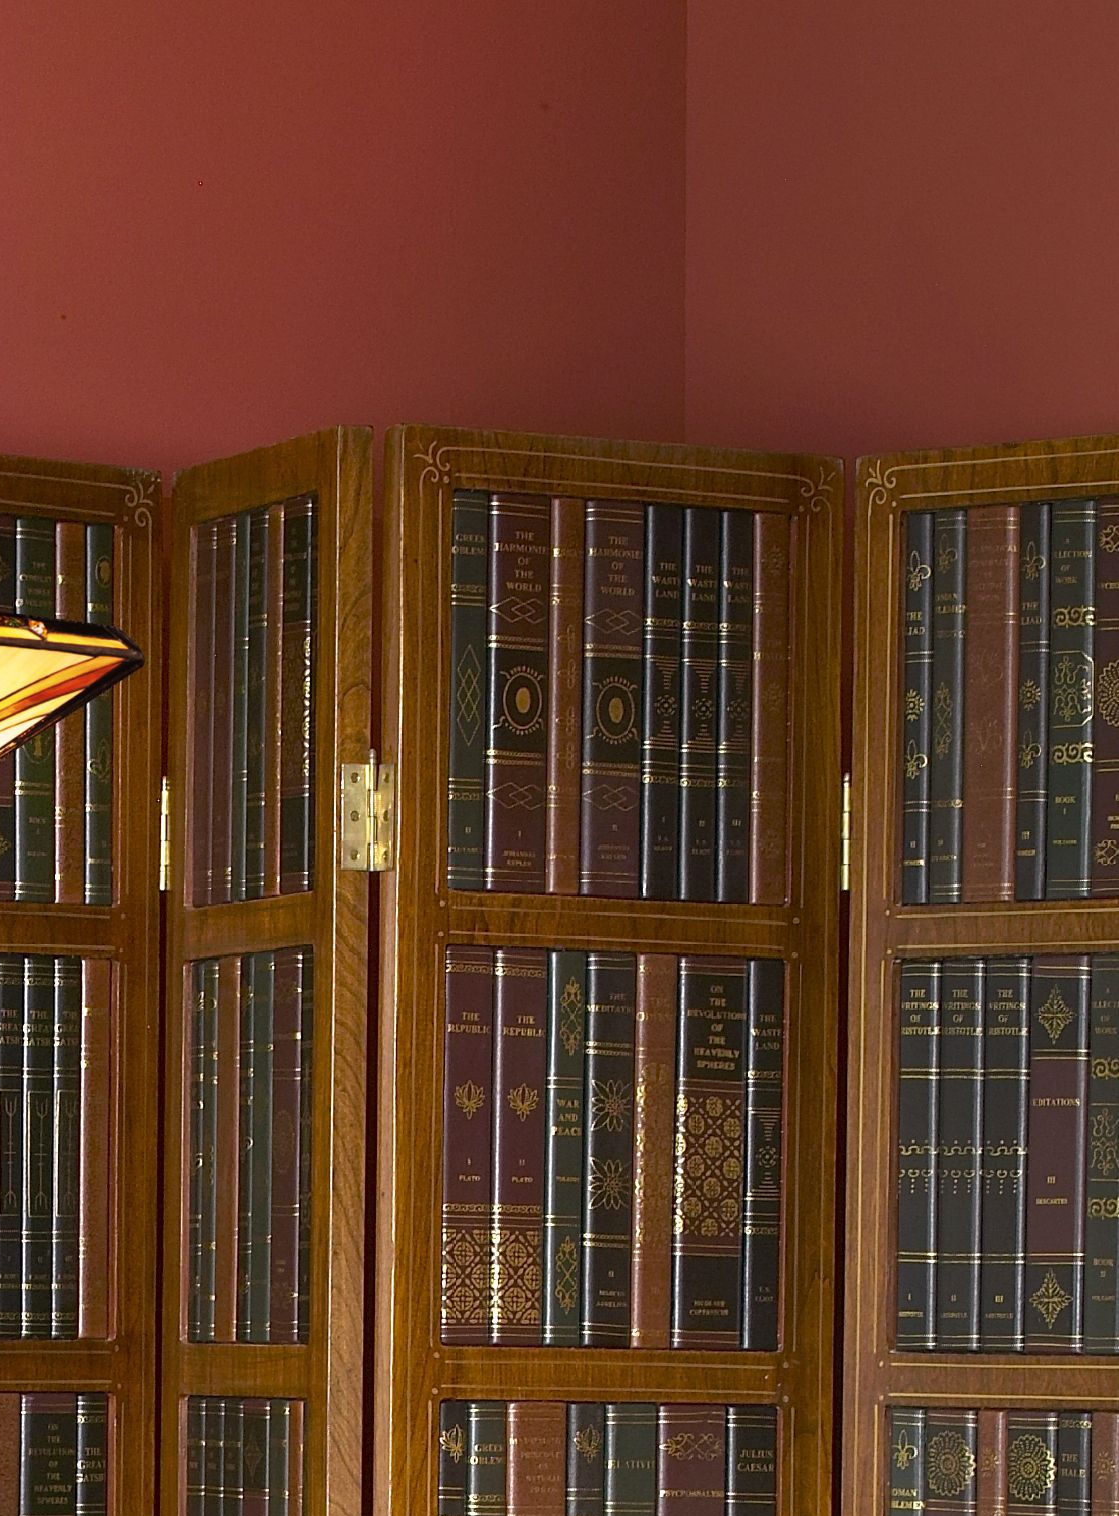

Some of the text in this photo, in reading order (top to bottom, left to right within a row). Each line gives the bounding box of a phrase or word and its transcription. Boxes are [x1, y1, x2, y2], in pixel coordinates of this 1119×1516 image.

[507, 582, 541, 592] WORLD
[740, 1450, 773, 1458] JULIUS
[738, 1464, 774, 1472] CAESAR
